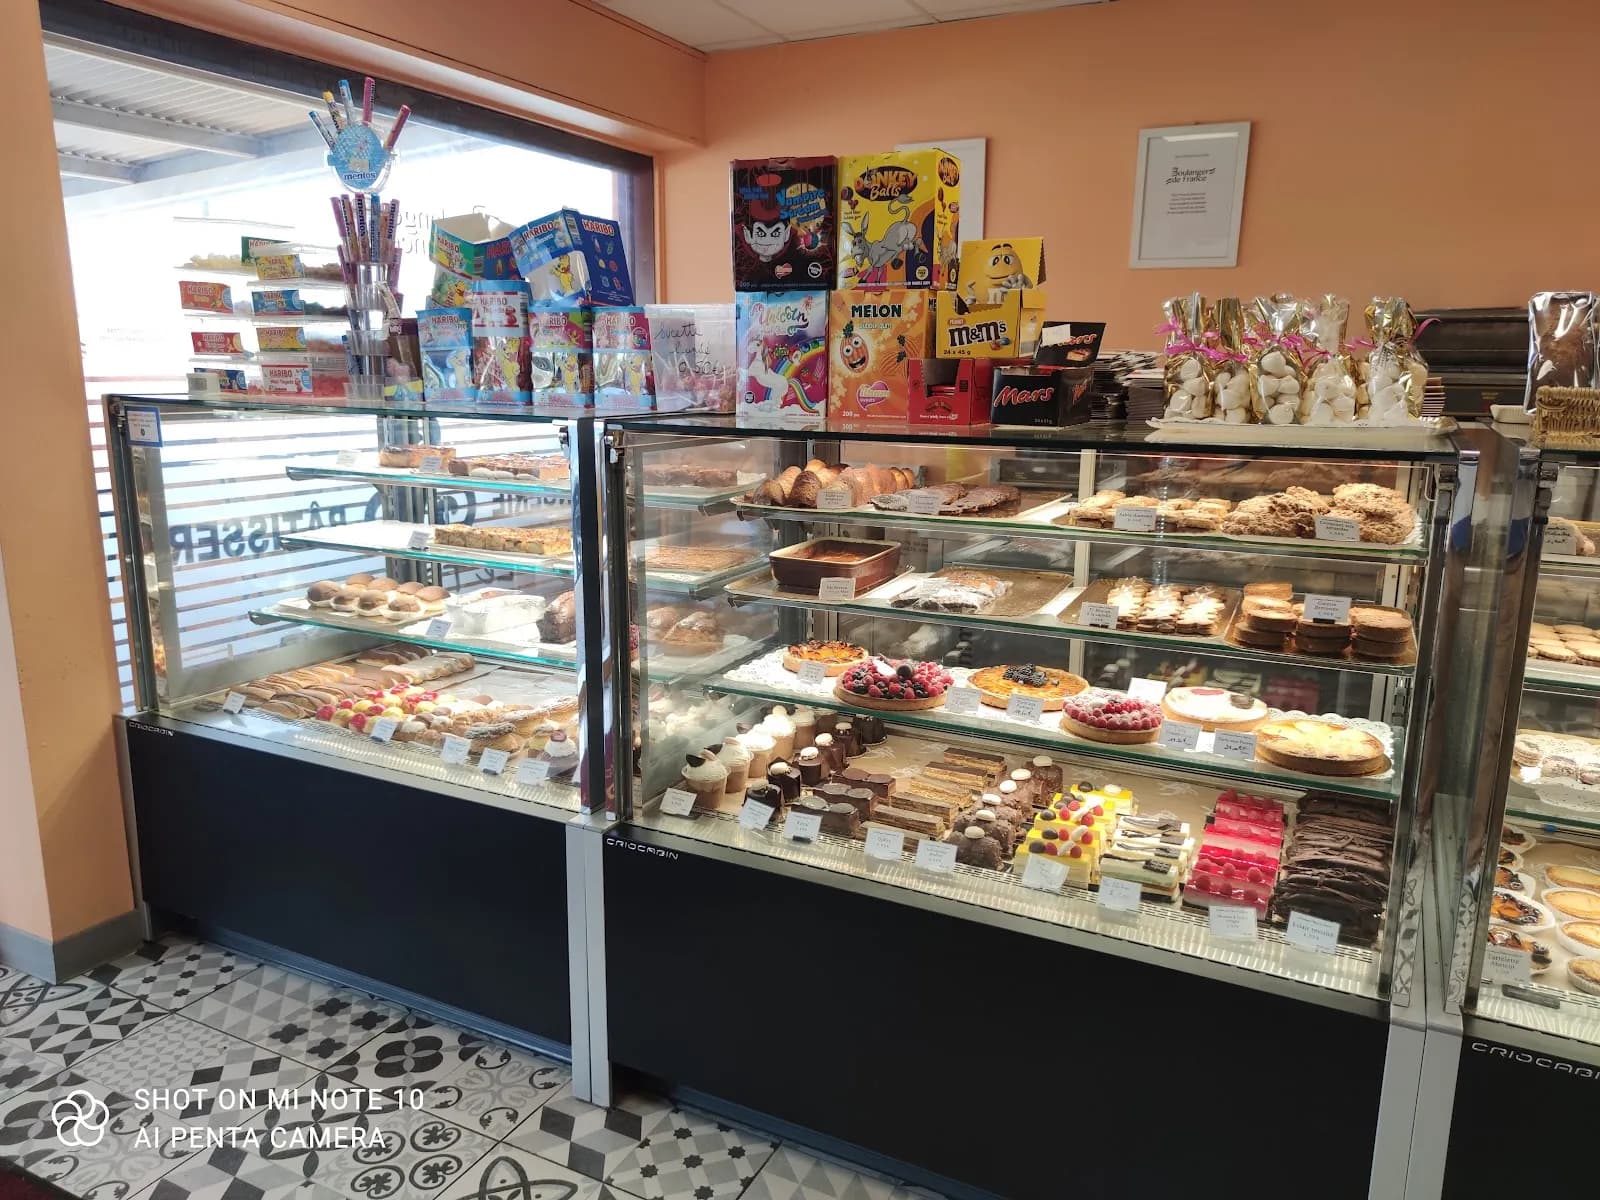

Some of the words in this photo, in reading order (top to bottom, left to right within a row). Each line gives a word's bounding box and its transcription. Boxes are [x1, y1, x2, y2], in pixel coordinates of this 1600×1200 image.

[344, 171, 376, 181] mentos
[1171, 166, 1216, 178] Boulangers
[869, 186, 902, 200] Balls
[357, 198, 366, 237] mentos
[387, 203, 396, 240] mentos
[522, 221, 554, 241] HARIBO
[431, 315, 459, 324] HARIBO
[851, 304, 902, 318] MELON
[993, 385, 1055, 408] Mars
[606, 837, 679, 860] CRIOCABIN
